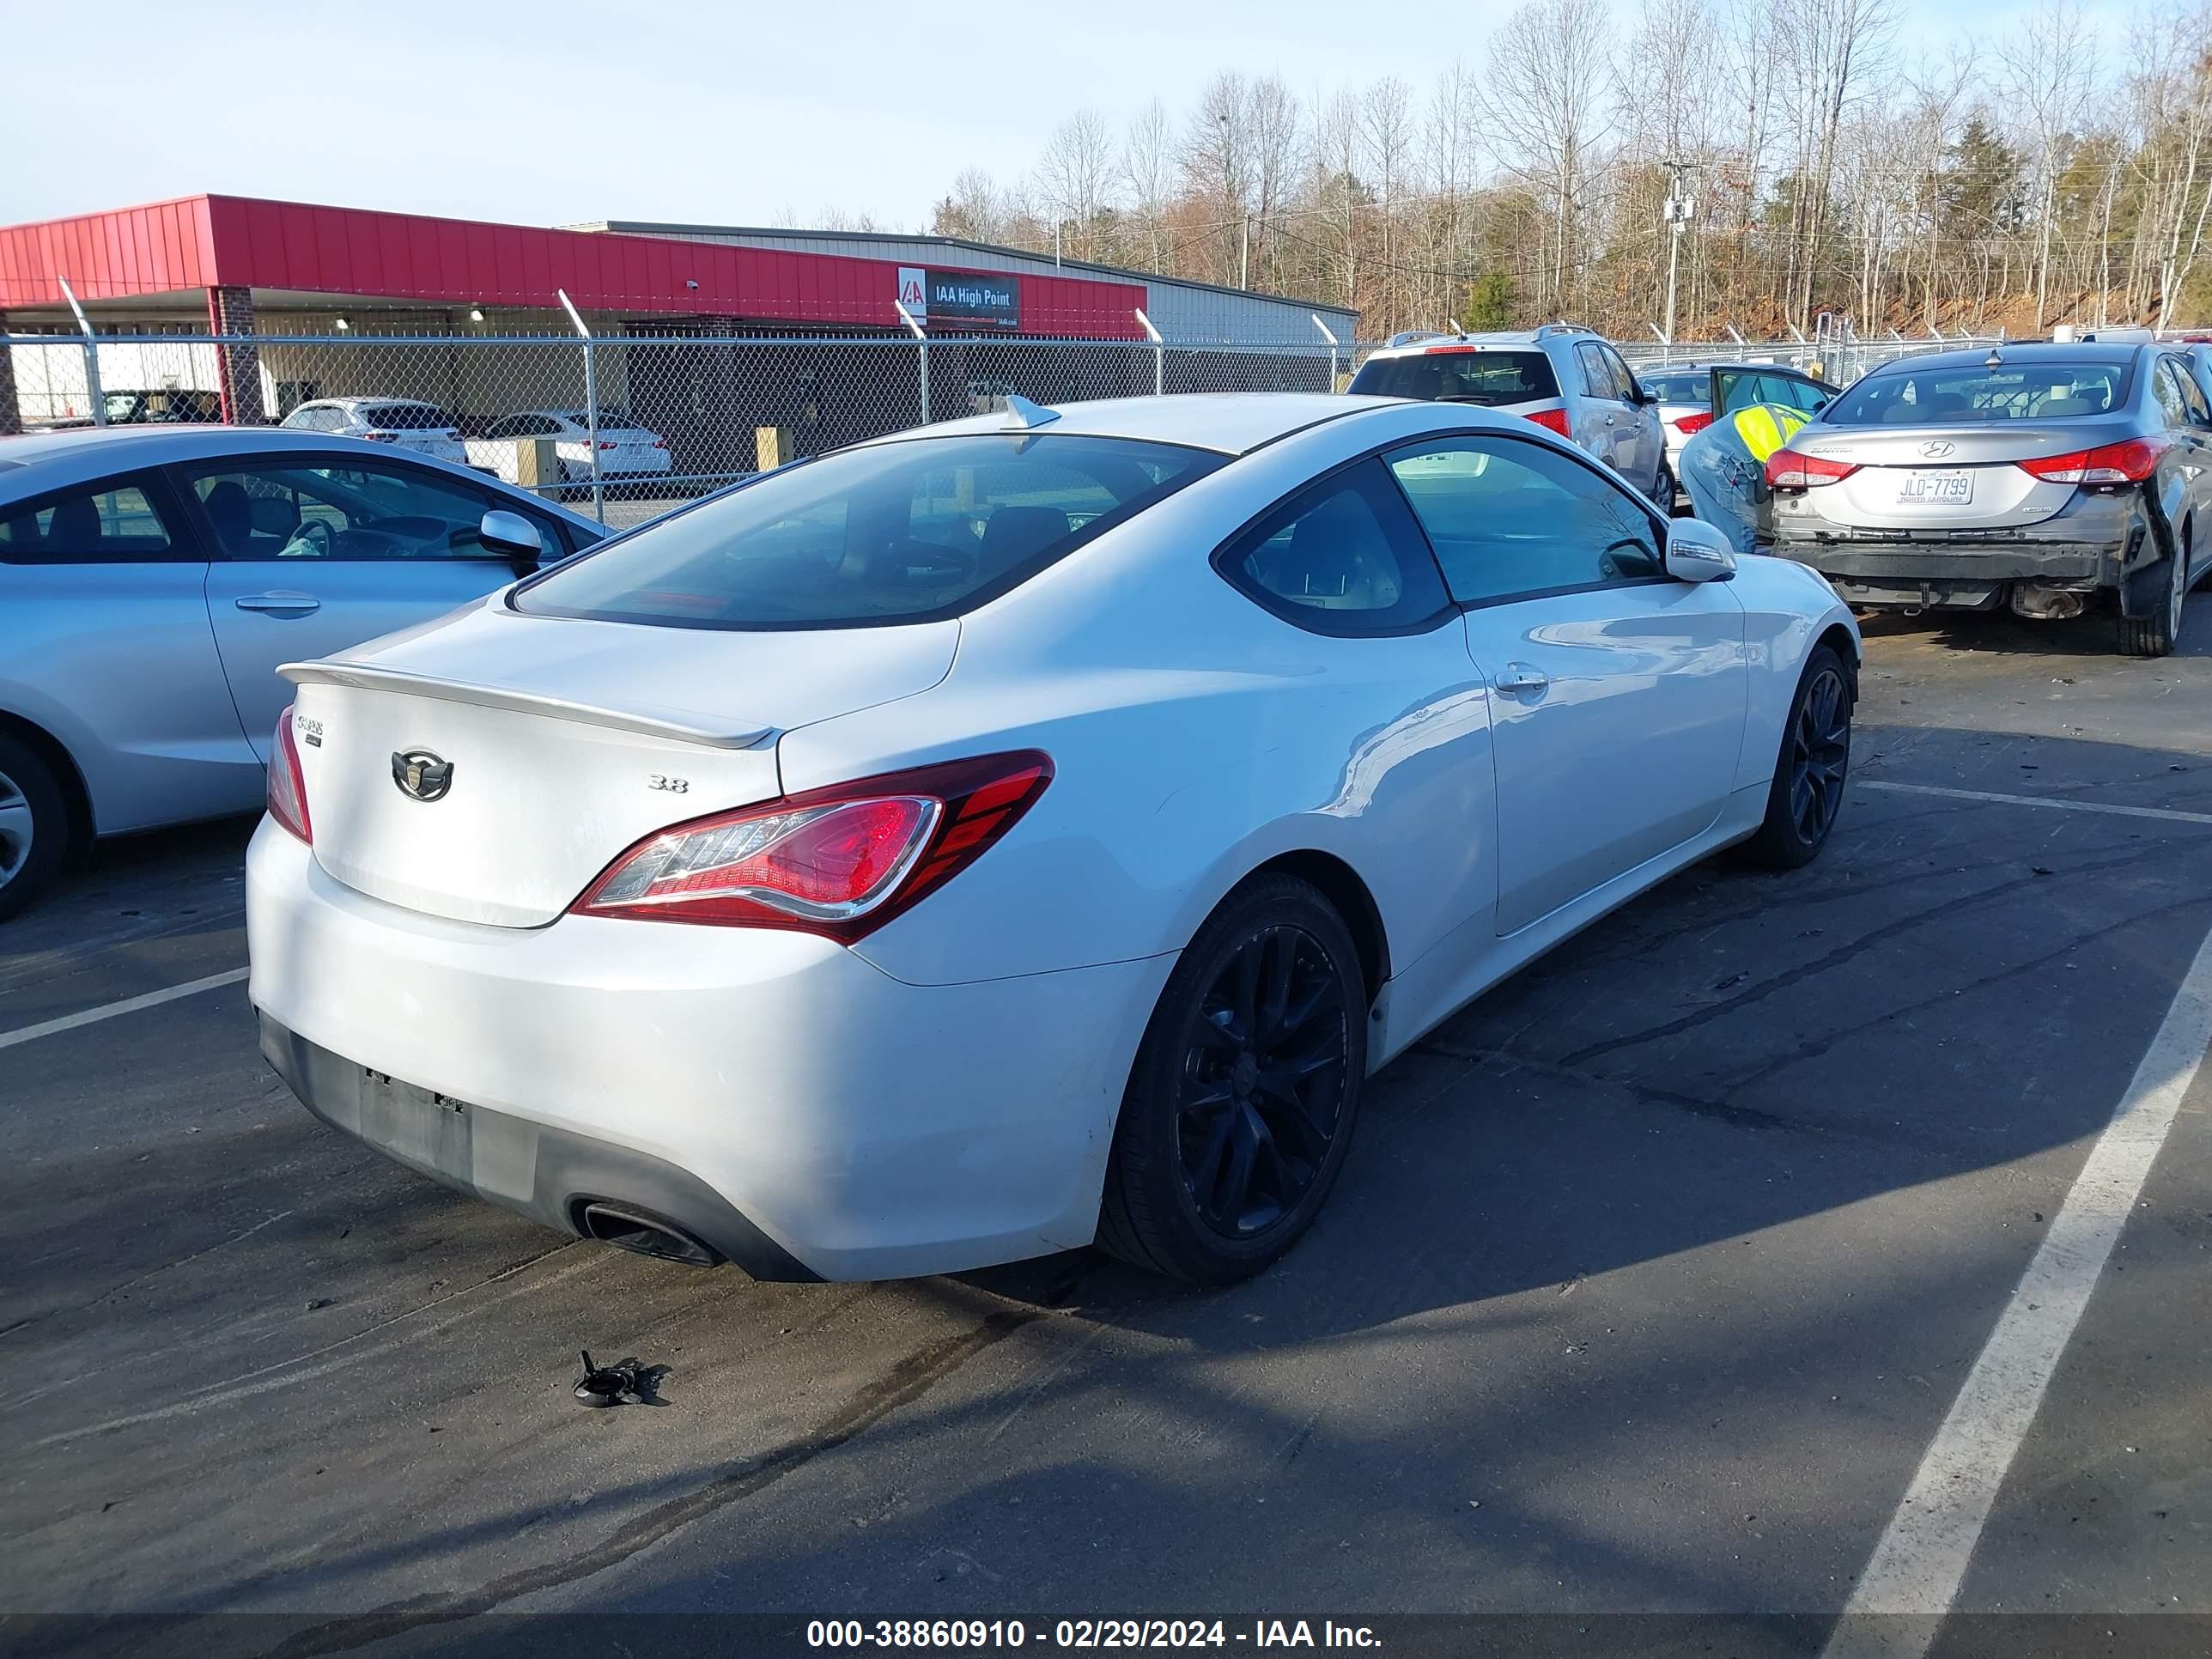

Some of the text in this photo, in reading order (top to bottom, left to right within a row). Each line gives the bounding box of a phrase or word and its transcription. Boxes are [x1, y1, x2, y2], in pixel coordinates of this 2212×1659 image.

[936, 285, 1010, 307] IAA High Point
